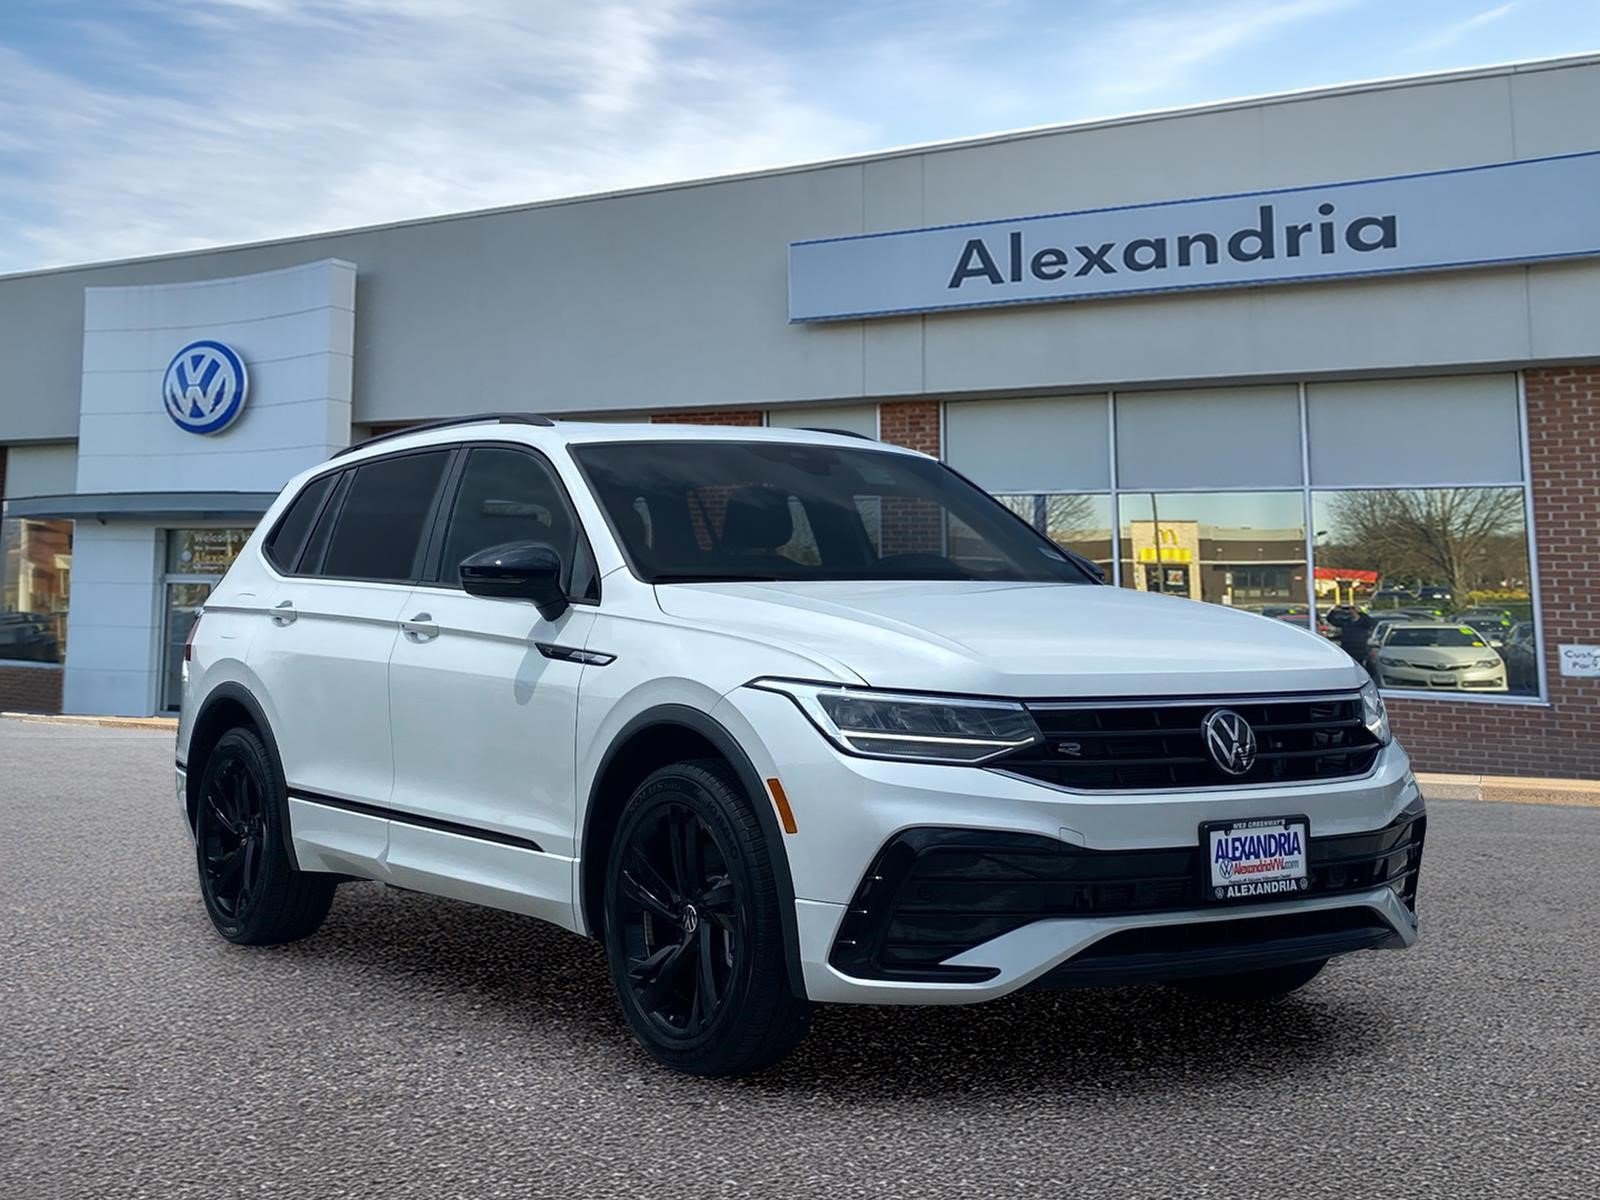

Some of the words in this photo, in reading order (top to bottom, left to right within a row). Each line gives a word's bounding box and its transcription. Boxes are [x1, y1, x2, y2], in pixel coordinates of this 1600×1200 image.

[947, 202, 1398, 289] Alexandria
[1215, 831, 1301, 864] ALEXANDRIA
[1227, 879, 1297, 898] ALEXANDRIA
